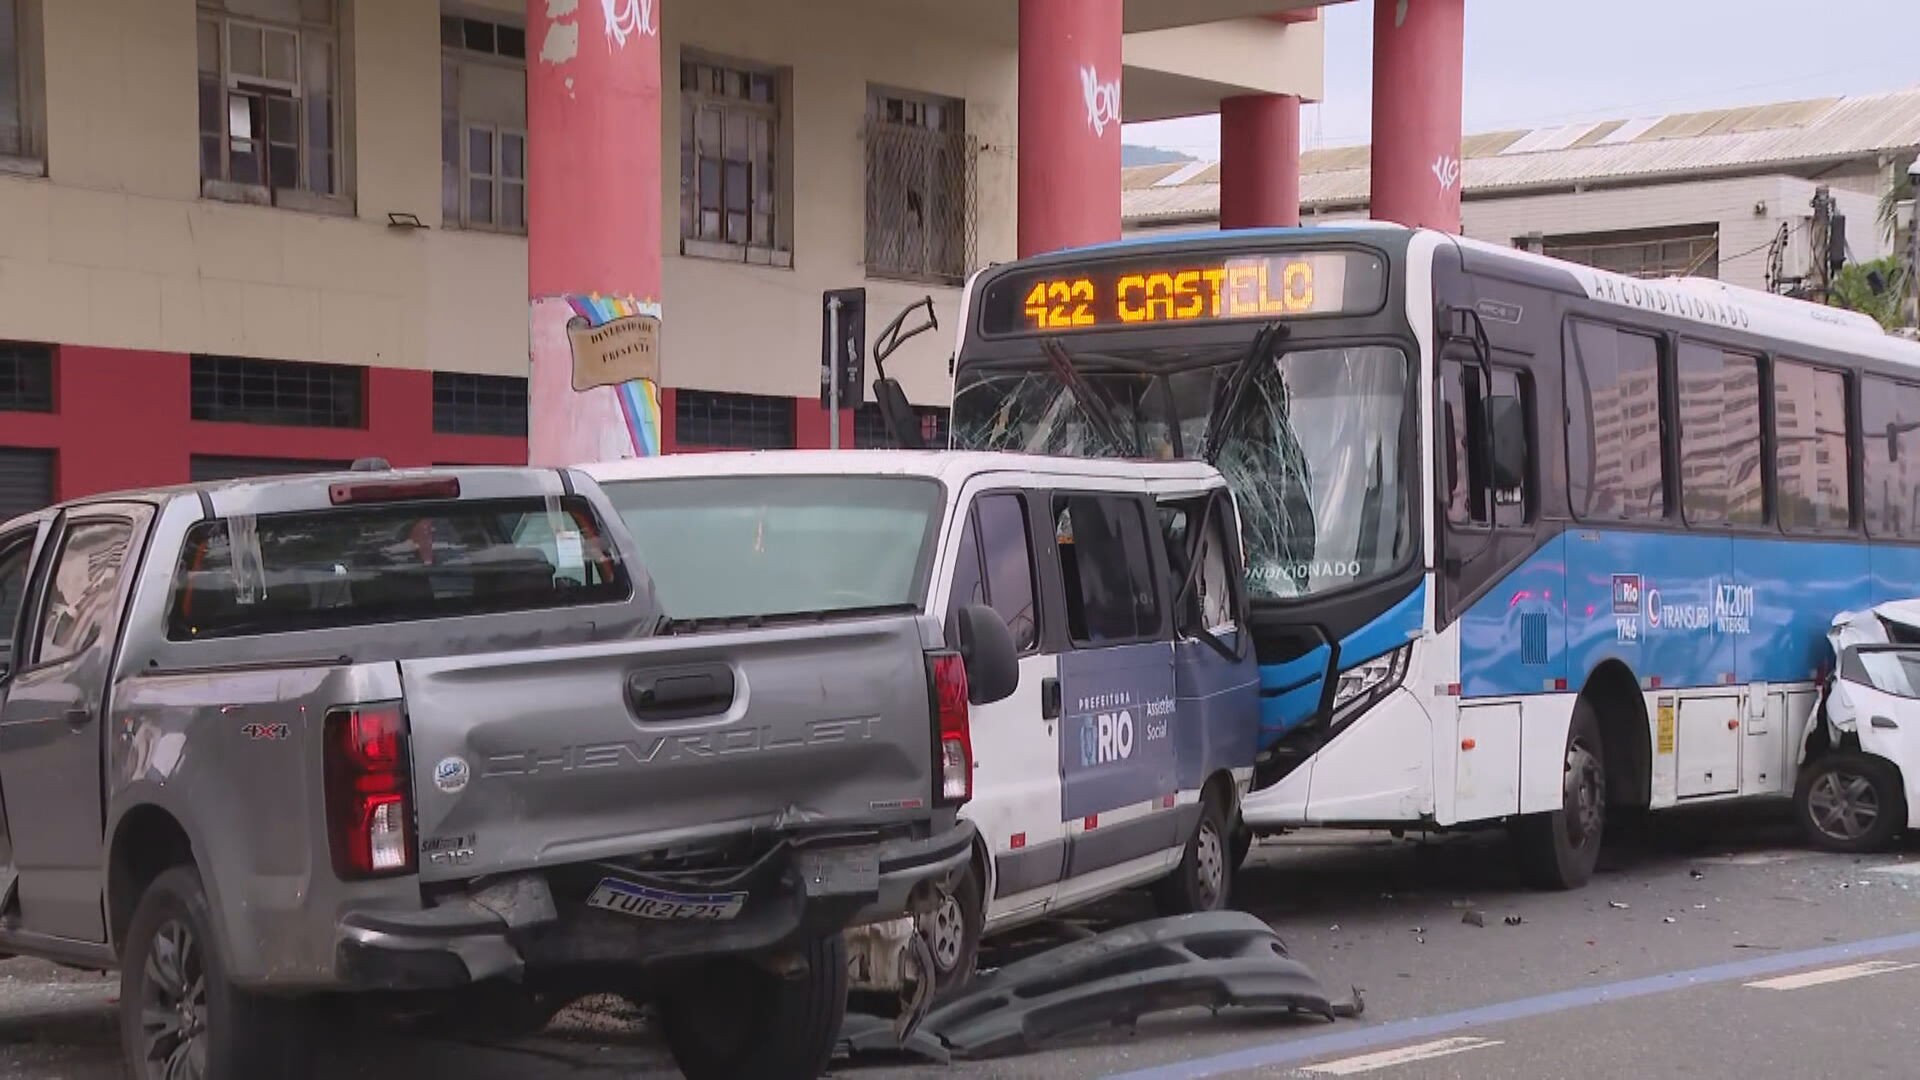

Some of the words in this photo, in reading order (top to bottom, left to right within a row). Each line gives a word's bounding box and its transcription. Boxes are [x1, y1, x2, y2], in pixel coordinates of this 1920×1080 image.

[1025, 279, 1095, 328] 422
[1117, 262, 1313, 323] CASTELO
[1594, 275, 1616, 300] AR
[1620, 282, 1750, 329] CONDICIONADO
[590, 321, 652, 344] DIVERSIDADE
[1623, 582, 1638, 603] Rio
[1715, 584, 1754, 618] A72011
[1663, 605, 1710, 629] TRANSURB
[1079, 691, 1131, 711] PREFEITURA
[1098, 710, 1134, 764] RIO
[1147, 718, 1168, 740] Social
[481, 714, 881, 777] CHEVROLET
